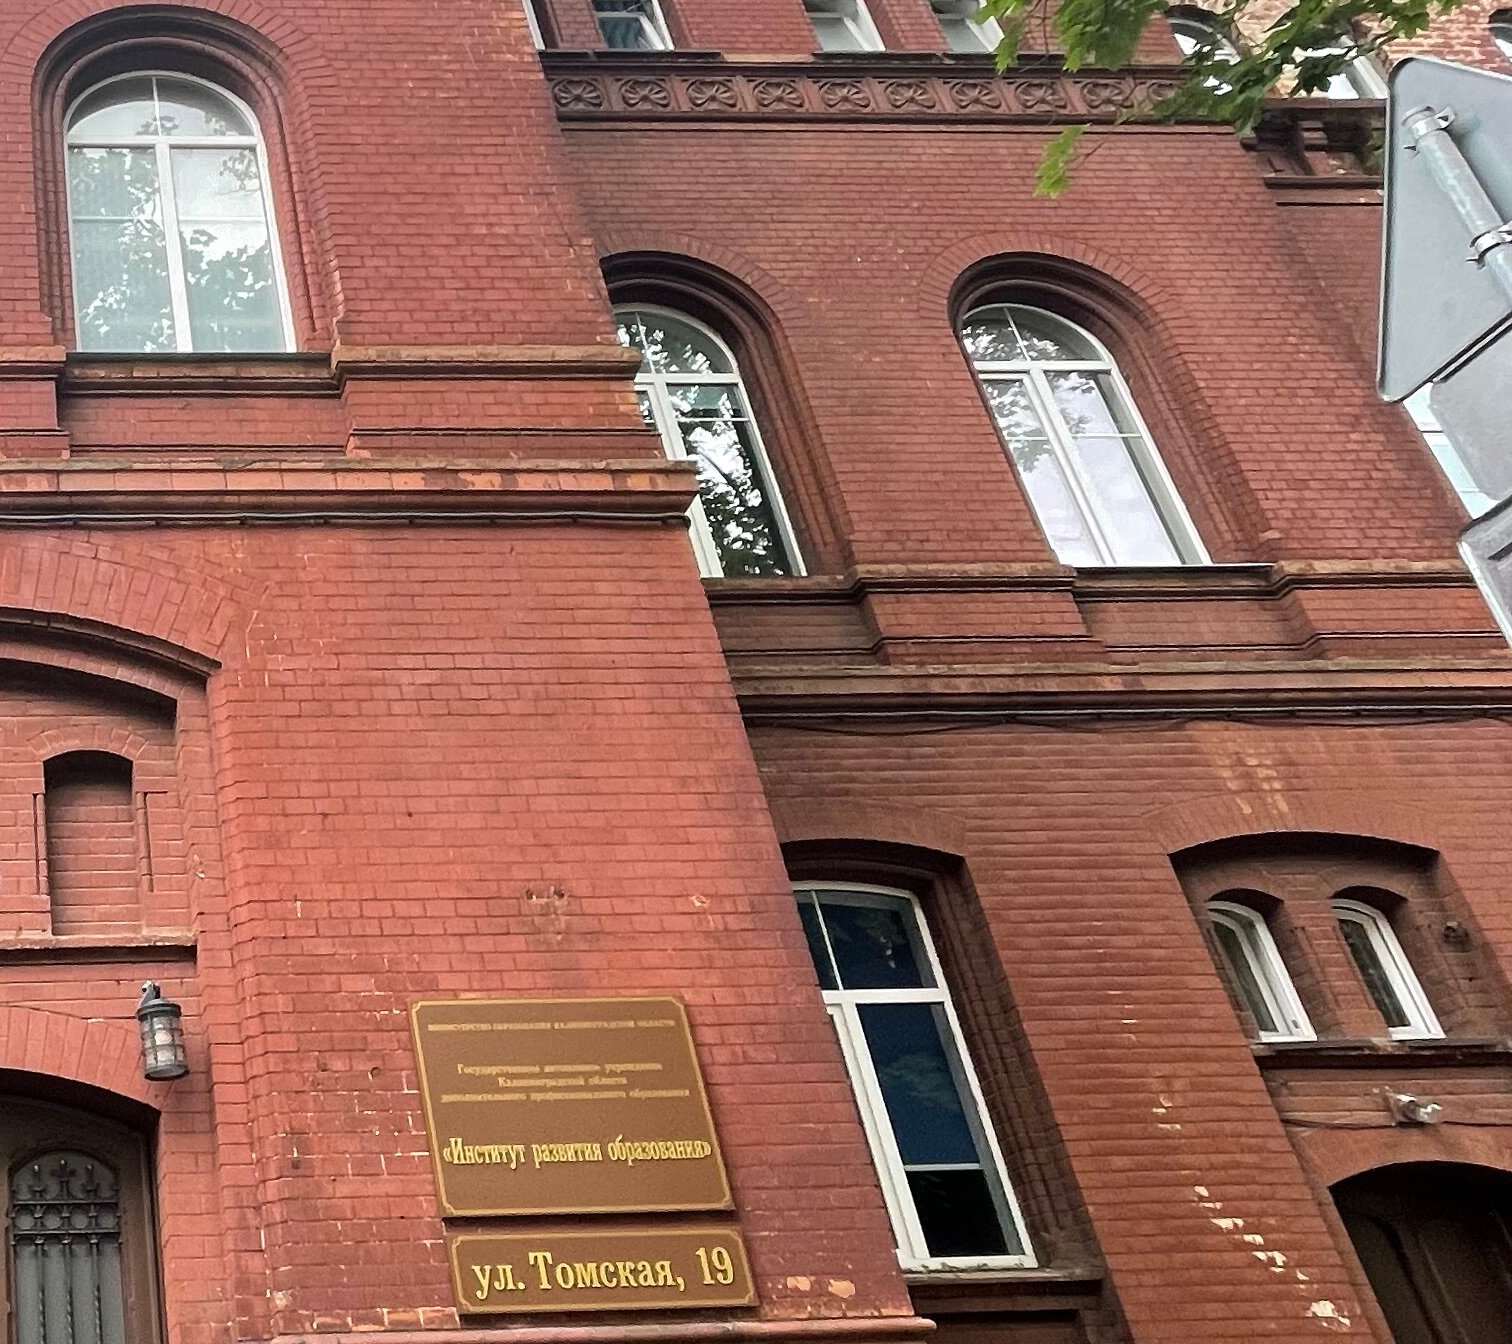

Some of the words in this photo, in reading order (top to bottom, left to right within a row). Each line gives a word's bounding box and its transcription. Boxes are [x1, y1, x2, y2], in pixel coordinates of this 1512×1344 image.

[443, 1137, 525, 1169] «Институт
[532, 1142, 602, 1168] развития
[608, 1134, 711, 1167] образования»
[472, 1264, 526, 1300] ул.
[528, 1251, 685, 1292] Томская,
[696, 1246, 734, 1285] 19
